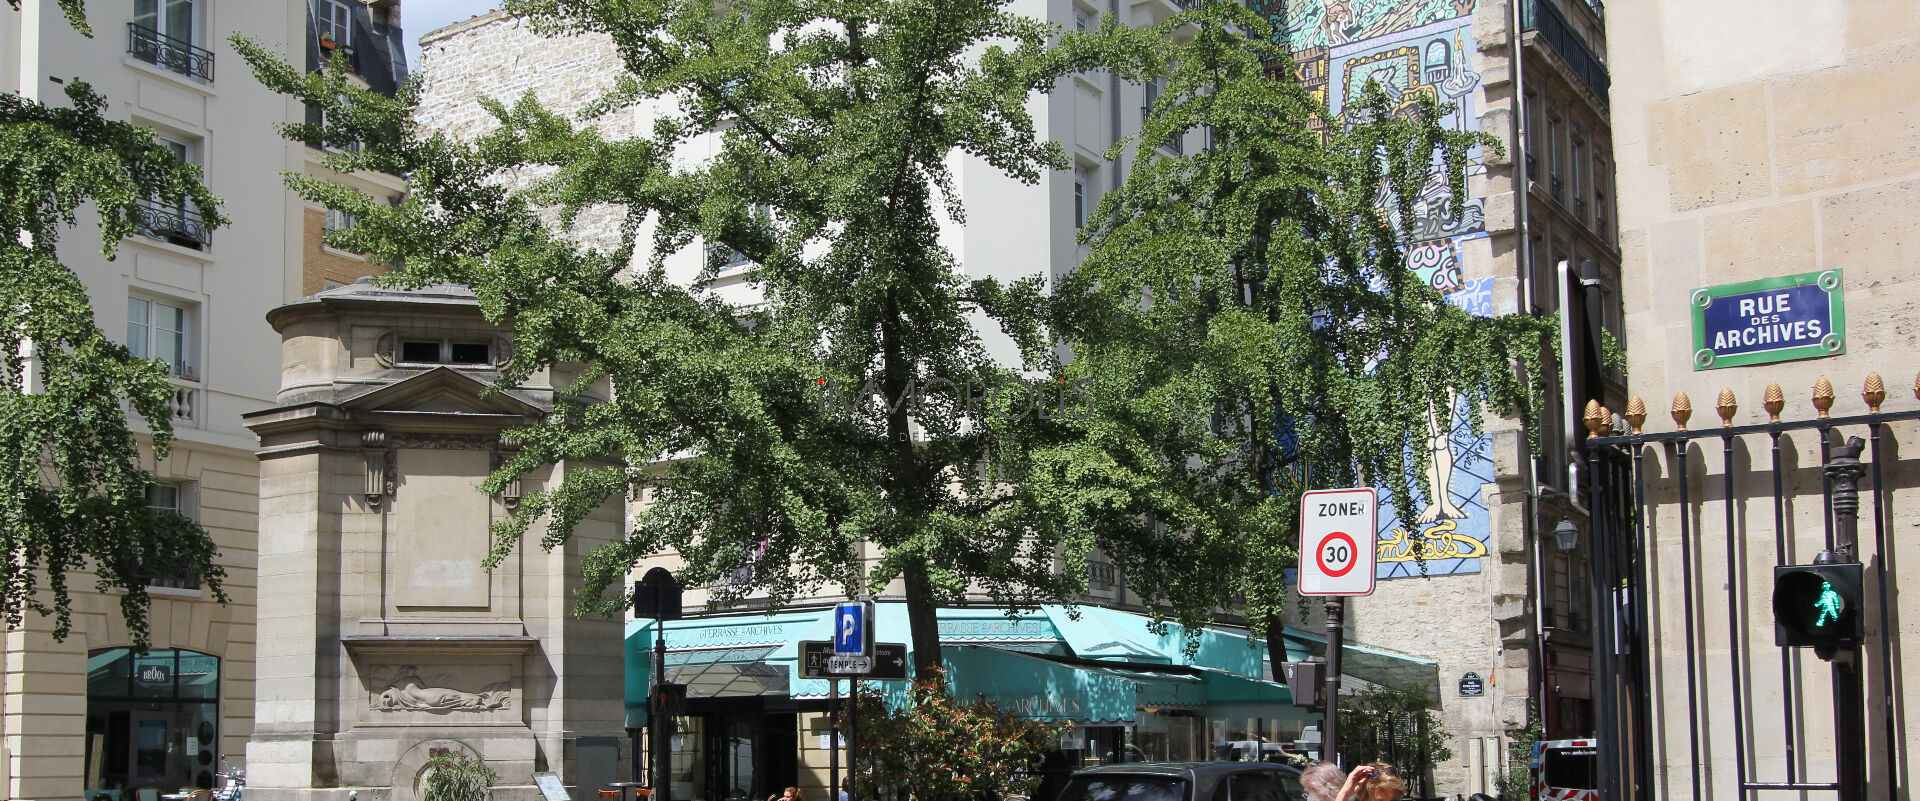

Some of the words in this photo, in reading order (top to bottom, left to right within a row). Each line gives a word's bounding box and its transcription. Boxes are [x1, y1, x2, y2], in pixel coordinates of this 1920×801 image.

[1739, 293, 1792, 318] RUE
[1751, 314, 1780, 326] DES
[1714, 319, 1822, 350] ARCHIVES
[1325, 546, 1348, 563] 30
[842, 614, 856, 645] P
[830, 660, 857, 669] TEMPLE
